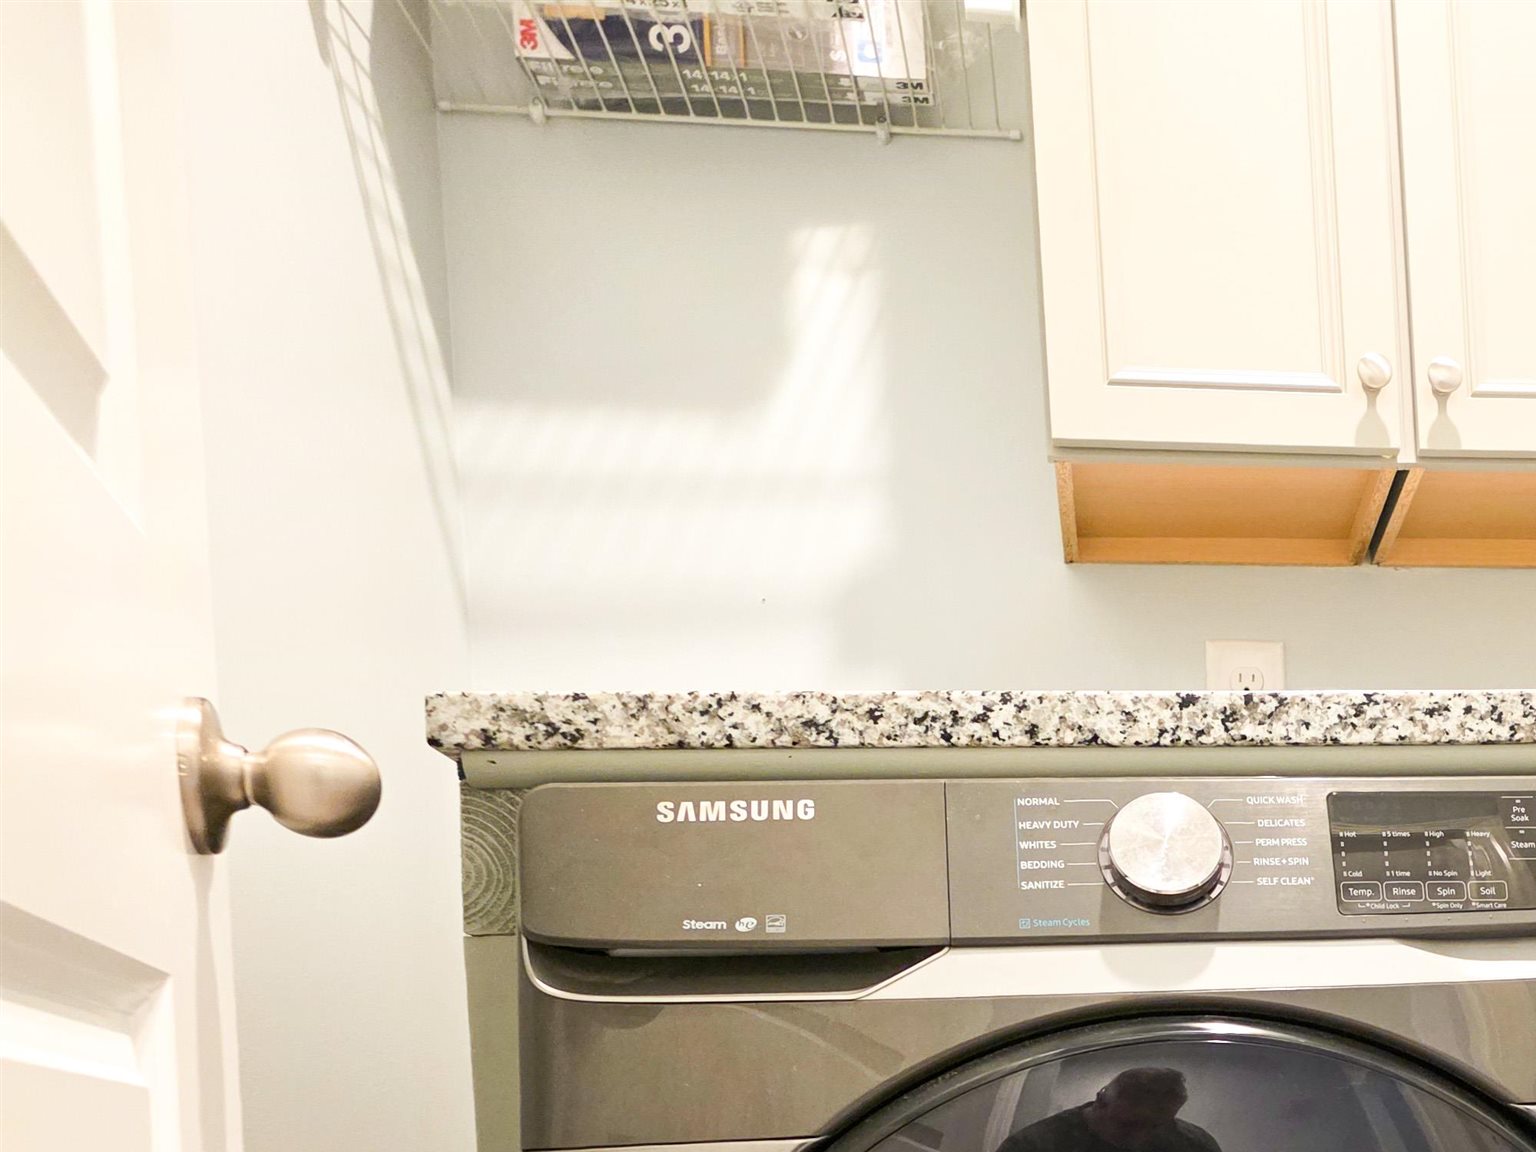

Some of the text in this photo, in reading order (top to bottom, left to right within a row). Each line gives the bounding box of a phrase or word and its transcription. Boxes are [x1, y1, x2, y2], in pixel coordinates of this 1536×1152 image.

[520, 19, 538, 50] 3M
[648, 24, 692, 54] 3
[896, 81, 924, 90] 3M
[1017, 797, 1060, 806] NORMAL
[1246, 796, 1274, 805] QUICK
[656, 799, 815, 823] SAMSUNG
[1257, 818, 1306, 828] DELICATES
[1511, 814, 1529, 822] Soak
[1019, 819, 1080, 830] HEAVY DUTY
[1019, 840, 1057, 849] WHITES
[1255, 837, 1308, 847] PERM PRESS
[1511, 841, 1536, 849] Steam
[1020, 860, 1065, 870] BEDDING
[1444, 870, 1458, 878] Spin
[1475, 870, 1492, 878] Light
[1021, 880, 1065, 890] SANITIZE
[1257, 877, 1279, 887] SELF
[1348, 887, 1375, 897] Temp.
[1392, 886, 1416, 896] Rinse
[1437, 886, 1456, 897] Spin
[1480, 886, 1496, 896] Soil
[1370, 902, 1386, 910] Child
[1436, 902, 1464, 910] Spin Only
[682, 919, 727, 930] Steam
[1033, 917, 1090, 928] Steam Cycles
